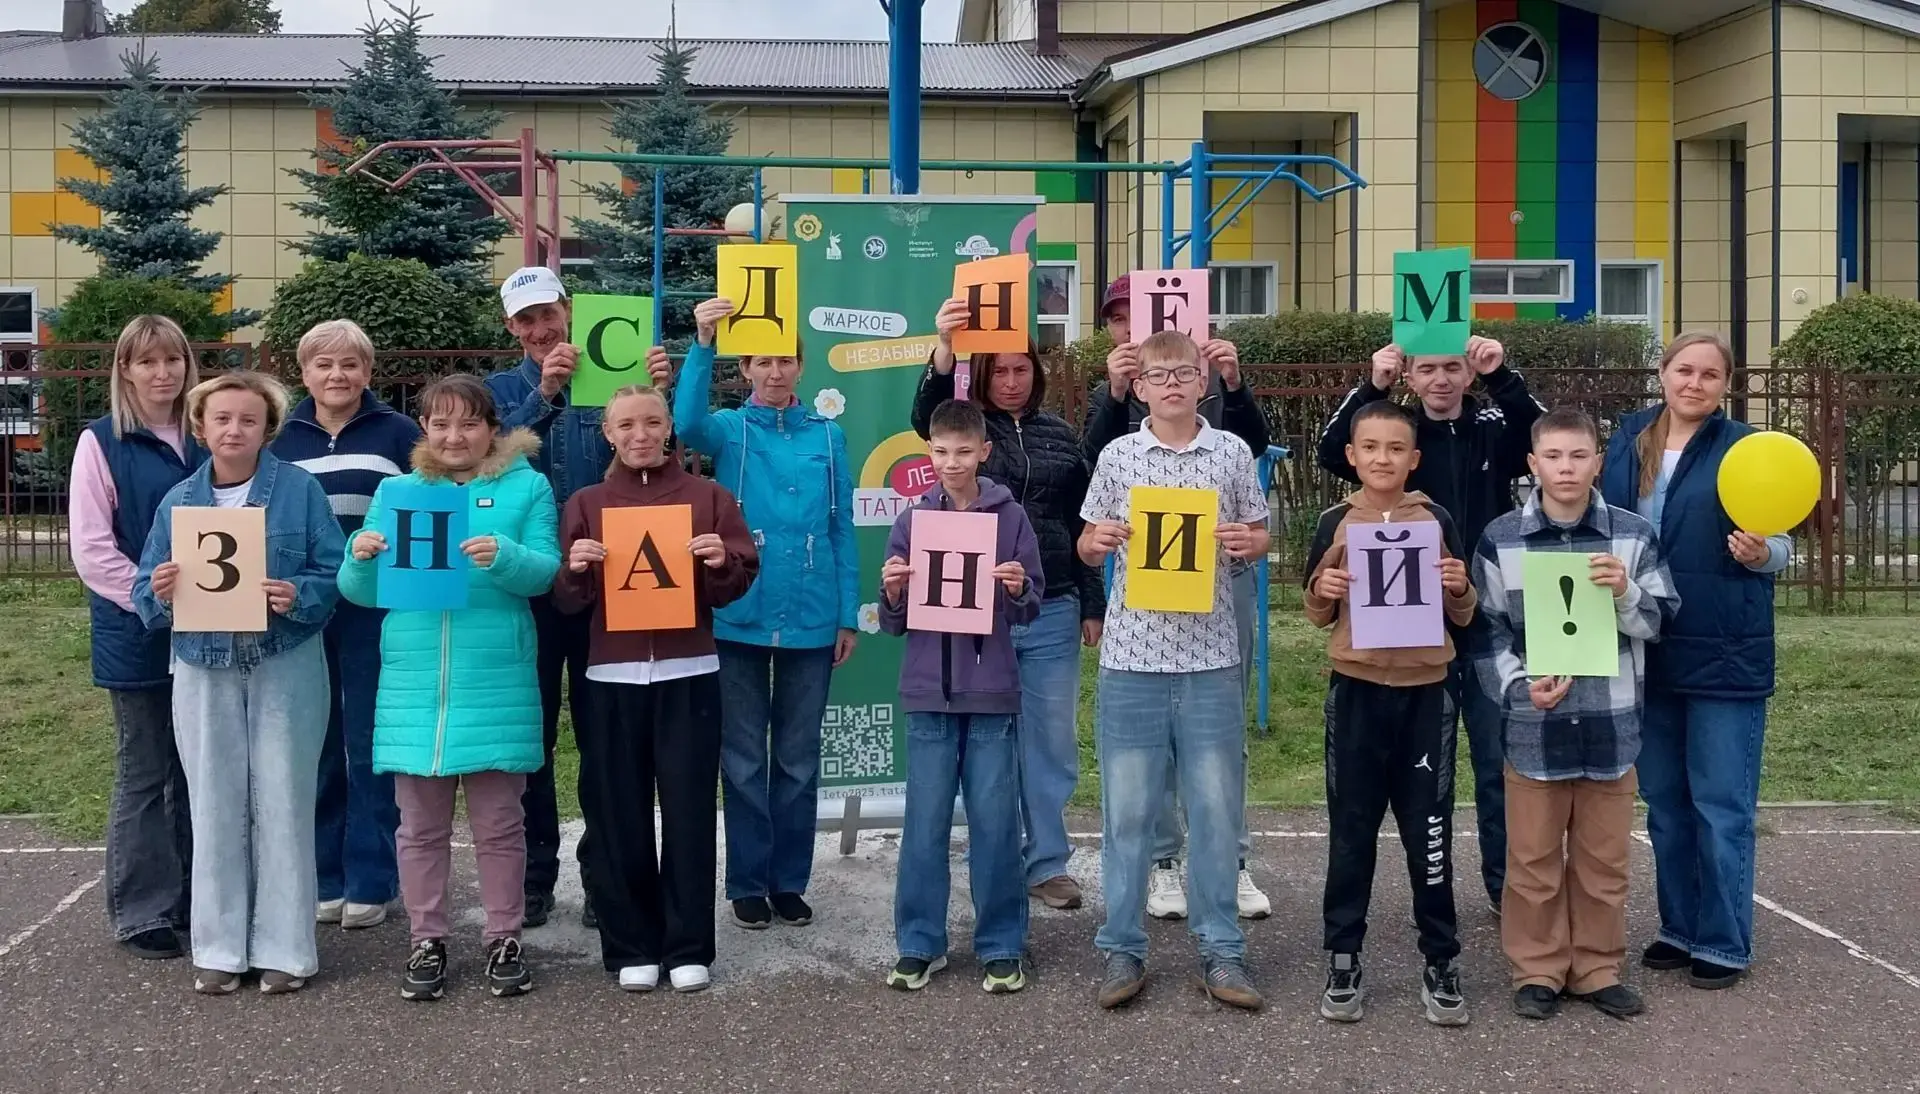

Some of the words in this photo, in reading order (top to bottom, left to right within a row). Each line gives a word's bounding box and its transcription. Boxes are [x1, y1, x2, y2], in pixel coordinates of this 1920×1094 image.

[511, 274, 538, 290] ЛДПР
[728, 266, 784, 335] Д
[961, 281, 1019, 332] Н
[1397, 269, 1467, 323] М
[586, 316, 640, 373] С
[823, 311, 892, 331] ЖАРКОЕ
[388, 508, 457, 570] Н
[617, 530, 681, 591] А
[1137, 510, 1206, 573] И
[1358, 529, 1431, 608] Й
[919, 549, 986, 611] Н
[1558, 575, 1578, 636] !
[1426, 815, 1444, 886] JORDAN
